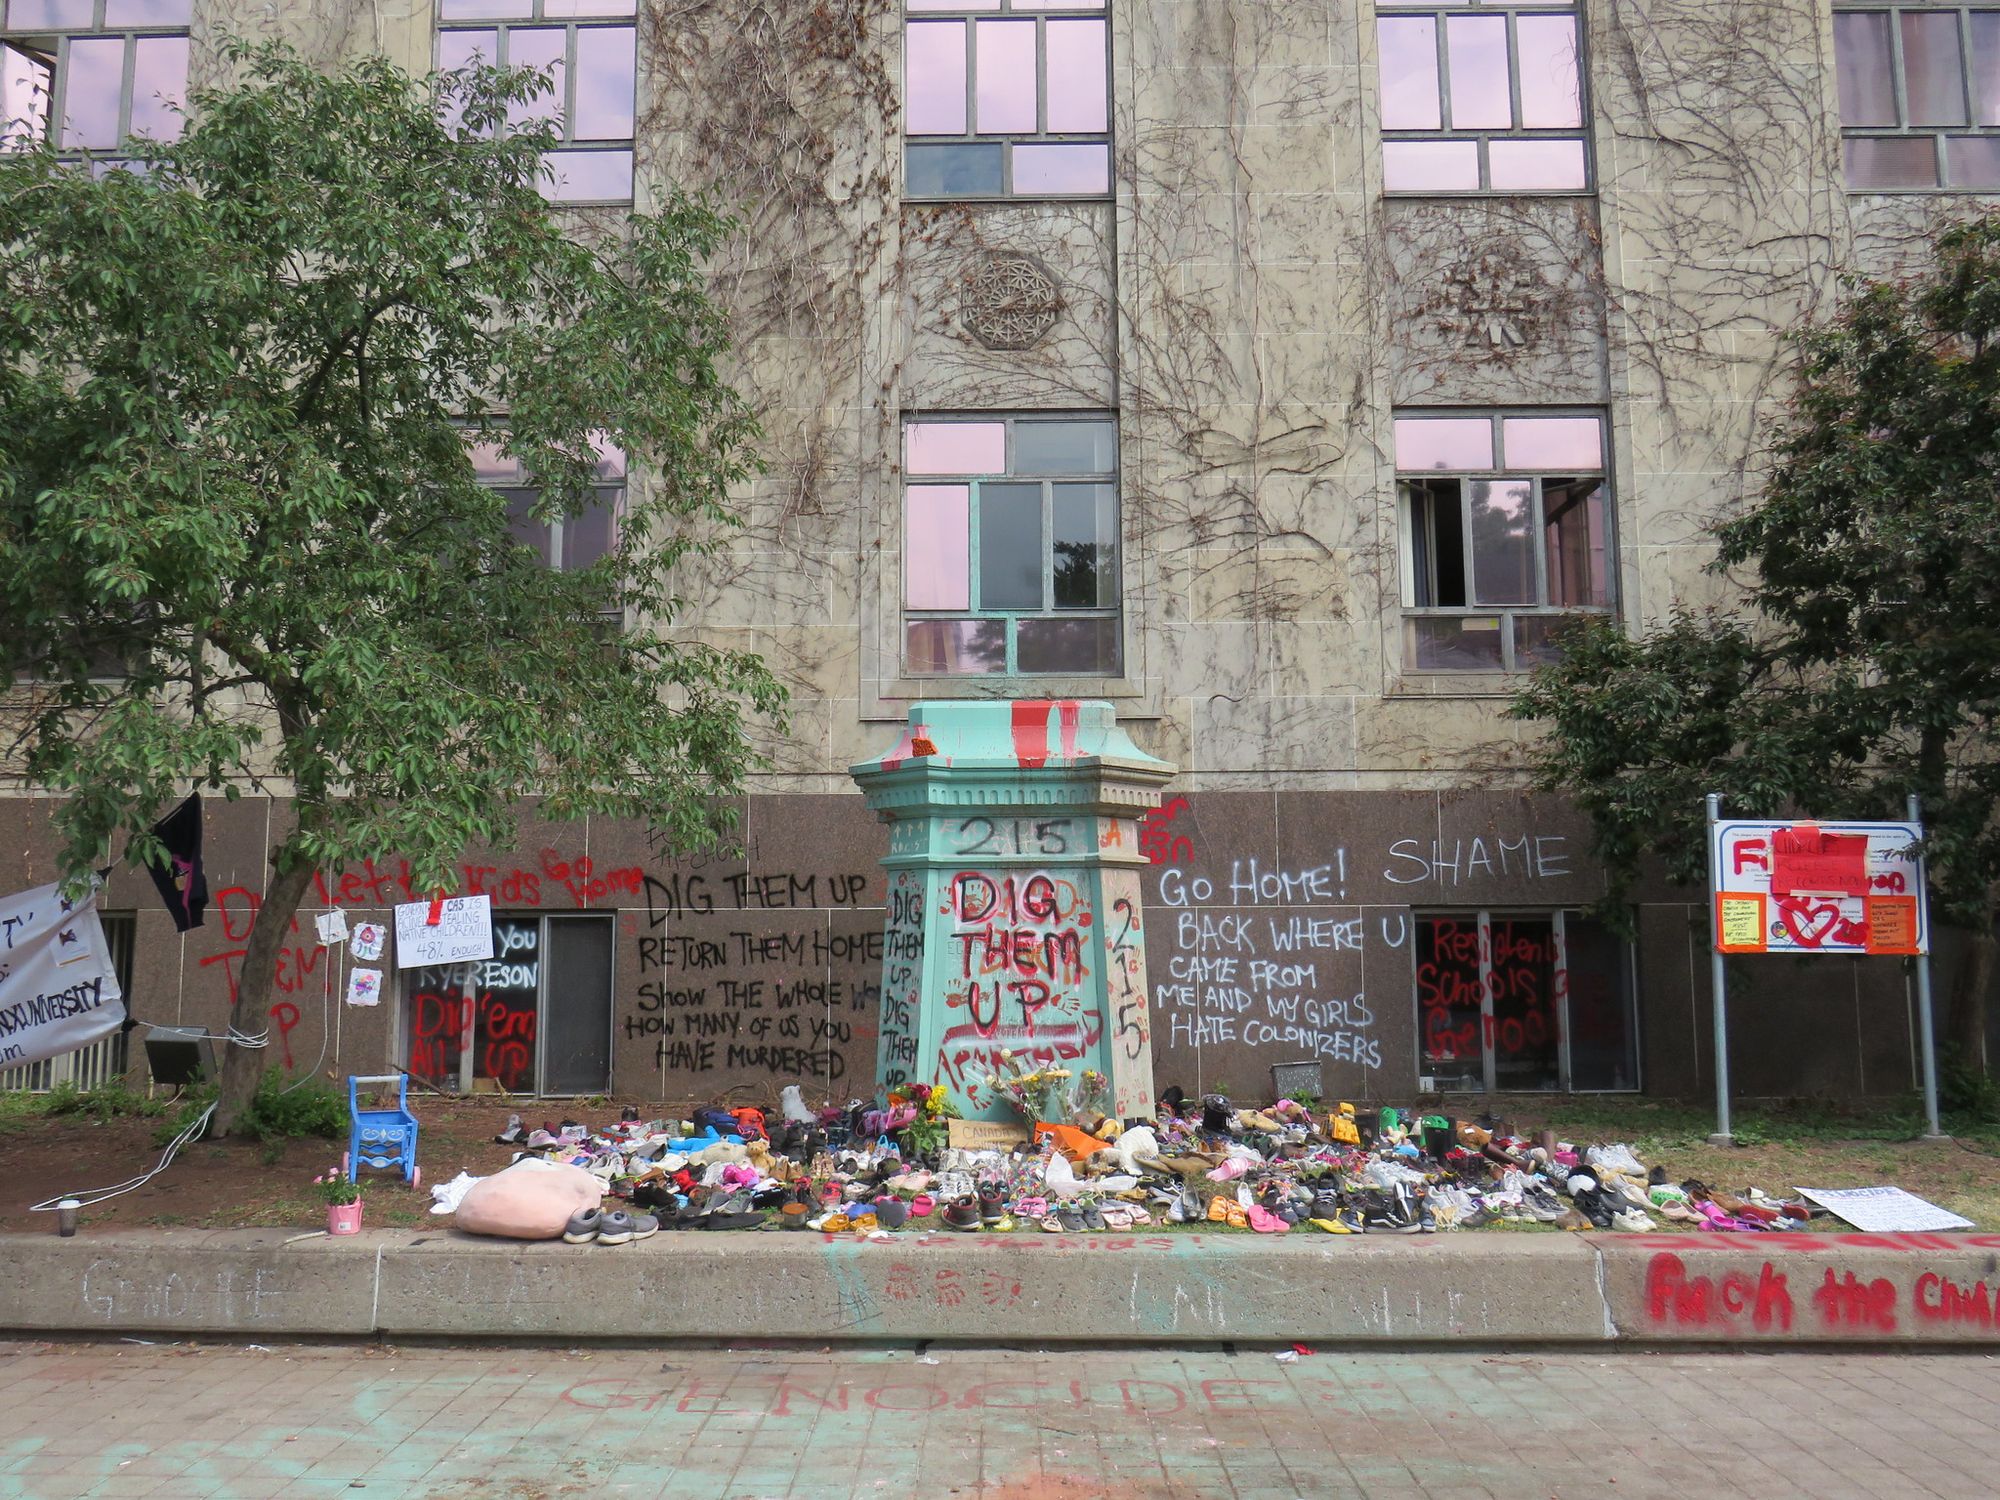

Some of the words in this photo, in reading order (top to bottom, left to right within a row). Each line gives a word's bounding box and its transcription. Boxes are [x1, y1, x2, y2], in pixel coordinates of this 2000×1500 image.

[957, 816, 1071, 855] 215
[1229, 848, 1345, 905] HOME!
[1384, 835, 1573, 886] SHAME
[441, 911, 480, 925] TEALING
[447, 899, 464, 912] CAS
[643, 873, 715, 928] DIG
[723, 872, 816, 909] THEM
[829, 875, 866, 904] UP
[894, 889, 923, 928] DIG
[951, 871, 1061, 927] DIG
[399, 927, 426, 942] NATIVE
[417, 940, 443, 960] 48%
[639, 936, 726, 972] RETURN
[729, 932, 805, 966] THEM
[812, 929, 884, 966] HOME
[887, 930, 925, 957] THEM
[1177, 912, 1255, 954] BACK
[1269, 916, 1365, 952] WHERE
[1382, 915, 1406, 948] U
[199, 946, 332, 1004] TEM
[891, 964, 912, 986] UP
[951, 922, 1082, 990] THEM
[1169, 956, 1238, 983] CAME
[1250, 959, 1317, 992] FROM
[717, 980, 764, 1009] THE
[775, 979, 841, 1009] WHOLE
[1112, 897, 1142, 1060] 215
[884, 990, 909, 1029] DIG
[968, 980, 1050, 1037] UP
[1156, 984, 1196, 1009] ME
[1205, 986, 1251, 1013] AND
[1266, 994, 1299, 1023] MY
[1304, 992, 1374, 1028] GIRLS
[625, 1016, 675, 1040] HOW
[685, 1012, 740, 1038] MANY
[750, 1017, 772, 1041] OF
[779, 1014, 800, 1038] US
[809, 1016, 850, 1049] YOU
[1170, 1012, 1236, 1049] HATE
[1244, 1020, 1382, 1070] COLONIZERS
[655, 1040, 716, 1072] HAVE
[727, 1043, 845, 1080] MURDERED
[882, 1030, 919, 1073] THEM
[886, 1069, 907, 1086] UP
[1813, 1267, 1896, 1333] the
[559, 1377, 1283, 1418] GENOCIDE
